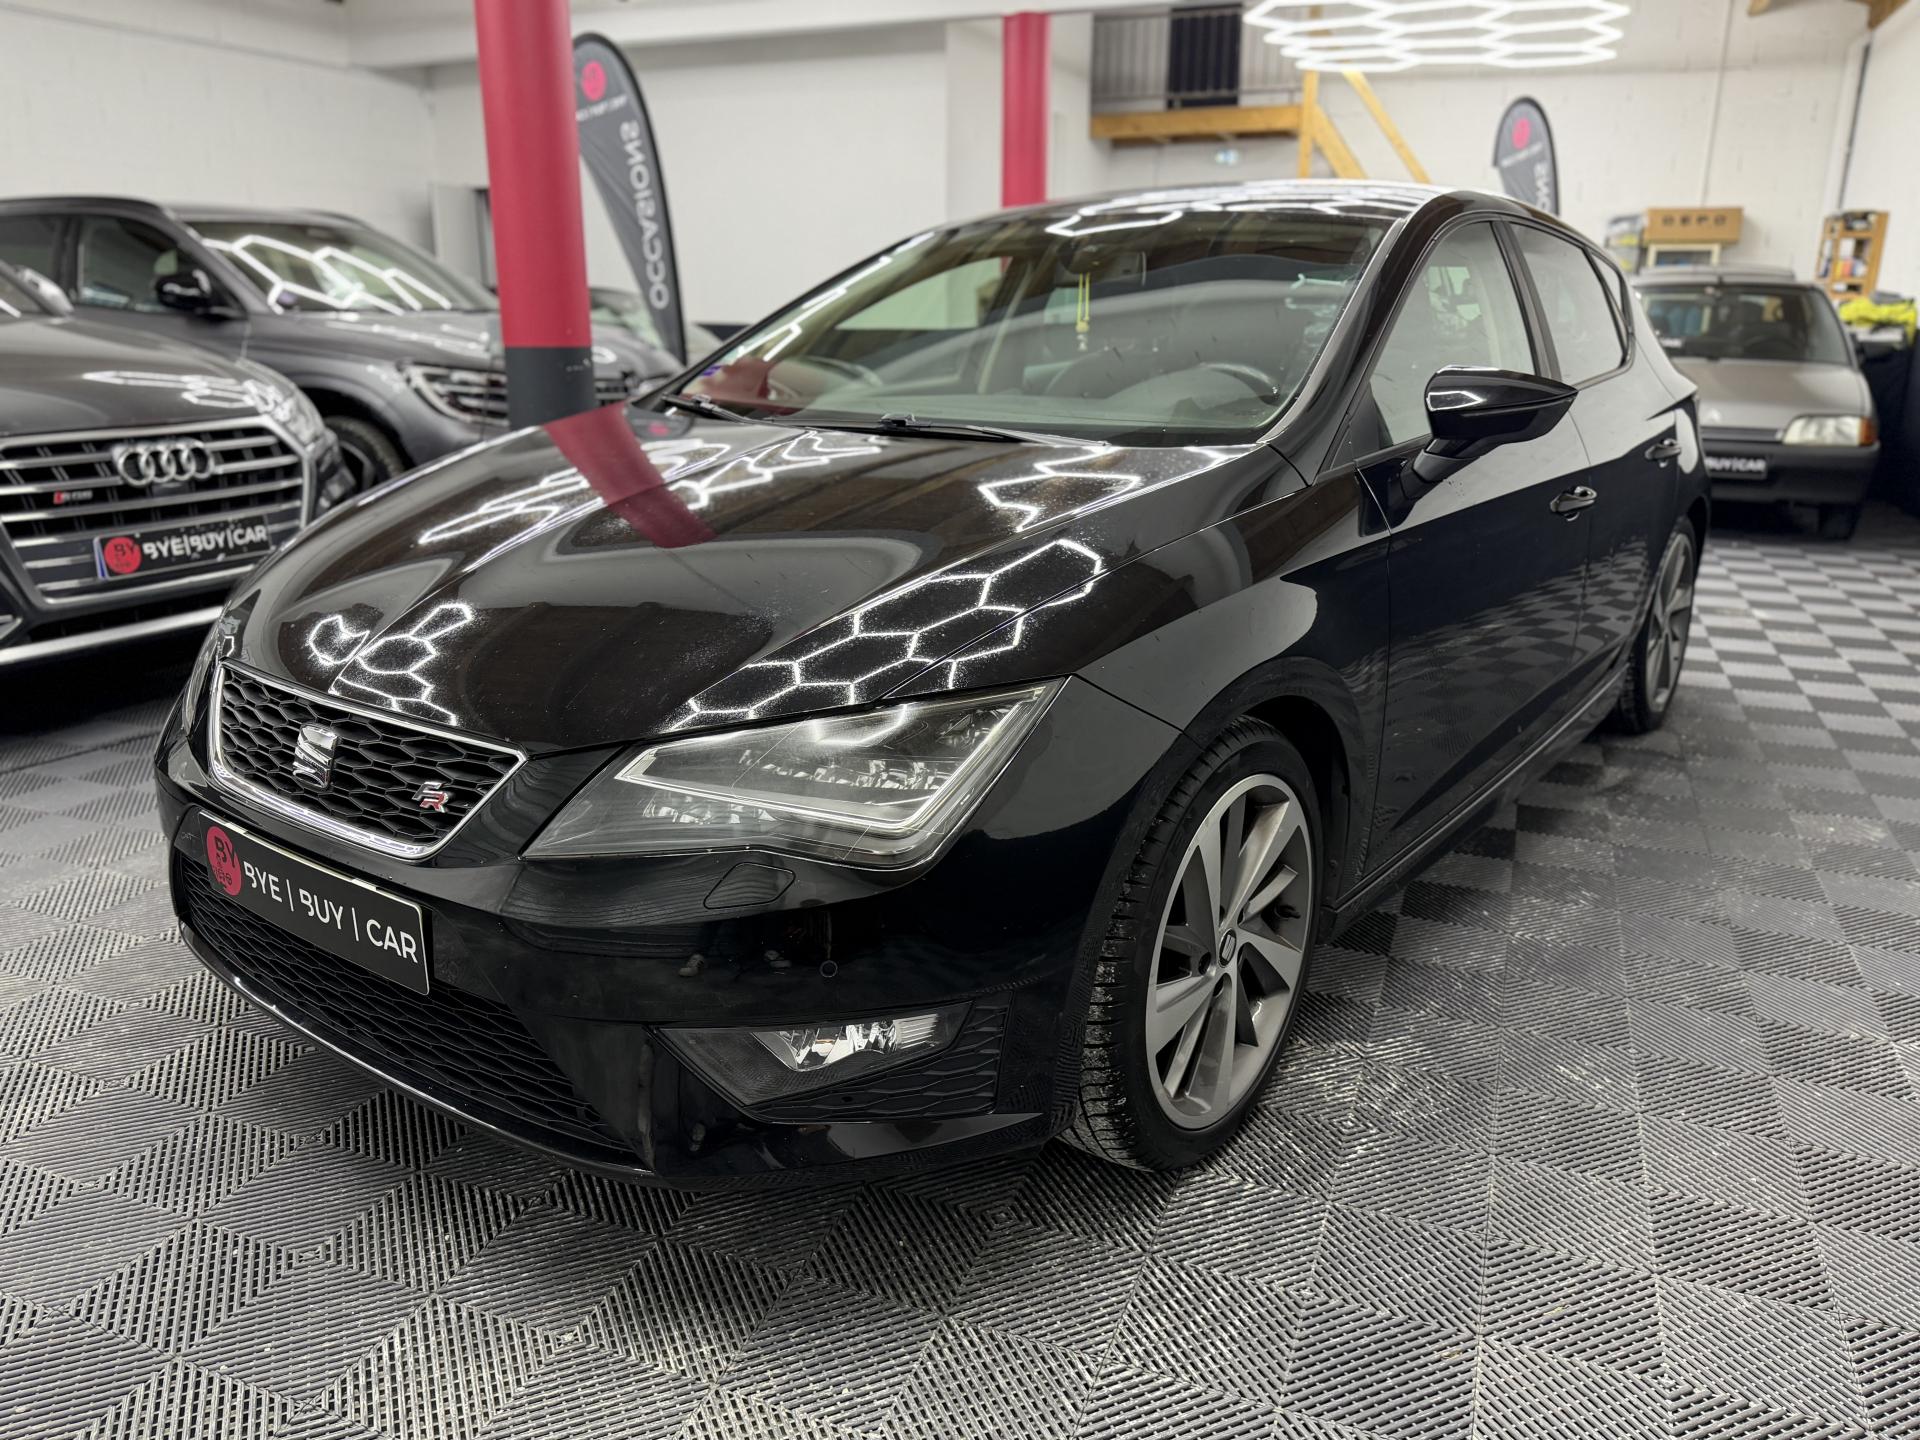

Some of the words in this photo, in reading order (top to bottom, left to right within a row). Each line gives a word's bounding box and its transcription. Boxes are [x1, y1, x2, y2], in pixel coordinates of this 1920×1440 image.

[142, 540, 185, 560] BYE
[190, 531, 226, 553] BUY
[233, 524, 268, 547] CAR
[243, 860, 283, 903] BYE
[299, 887, 343, 930] BUY
[366, 919, 418, 964] CAR
